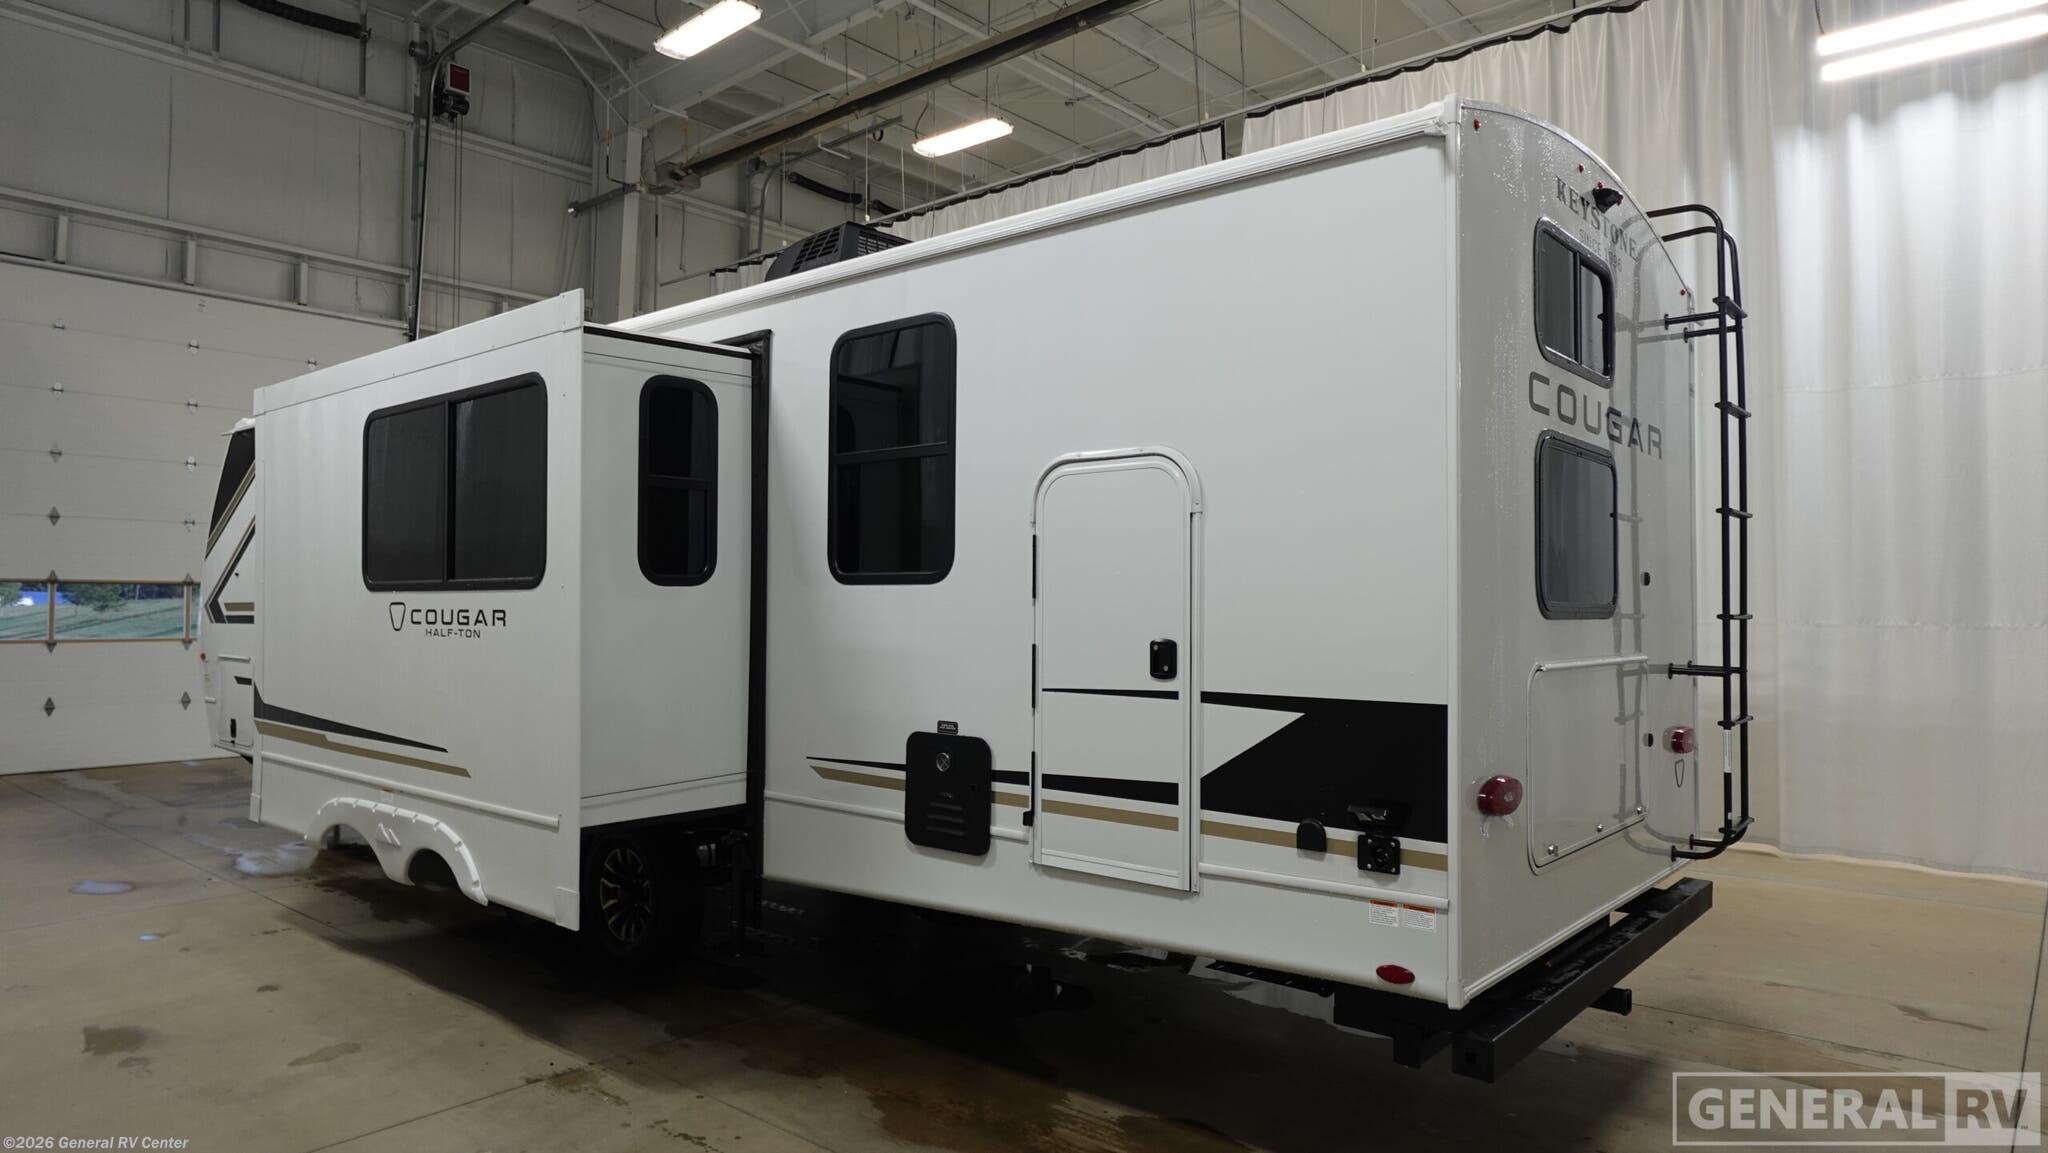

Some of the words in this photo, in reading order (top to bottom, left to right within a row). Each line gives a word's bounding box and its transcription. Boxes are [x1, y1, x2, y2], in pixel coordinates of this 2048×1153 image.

[1555, 175, 1640, 262] KEYSTONE
[1528, 371, 1662, 459] COUGAR
[410, 609, 507, 627] COUGAR
[425, 628, 481, 639] HALF-TON
